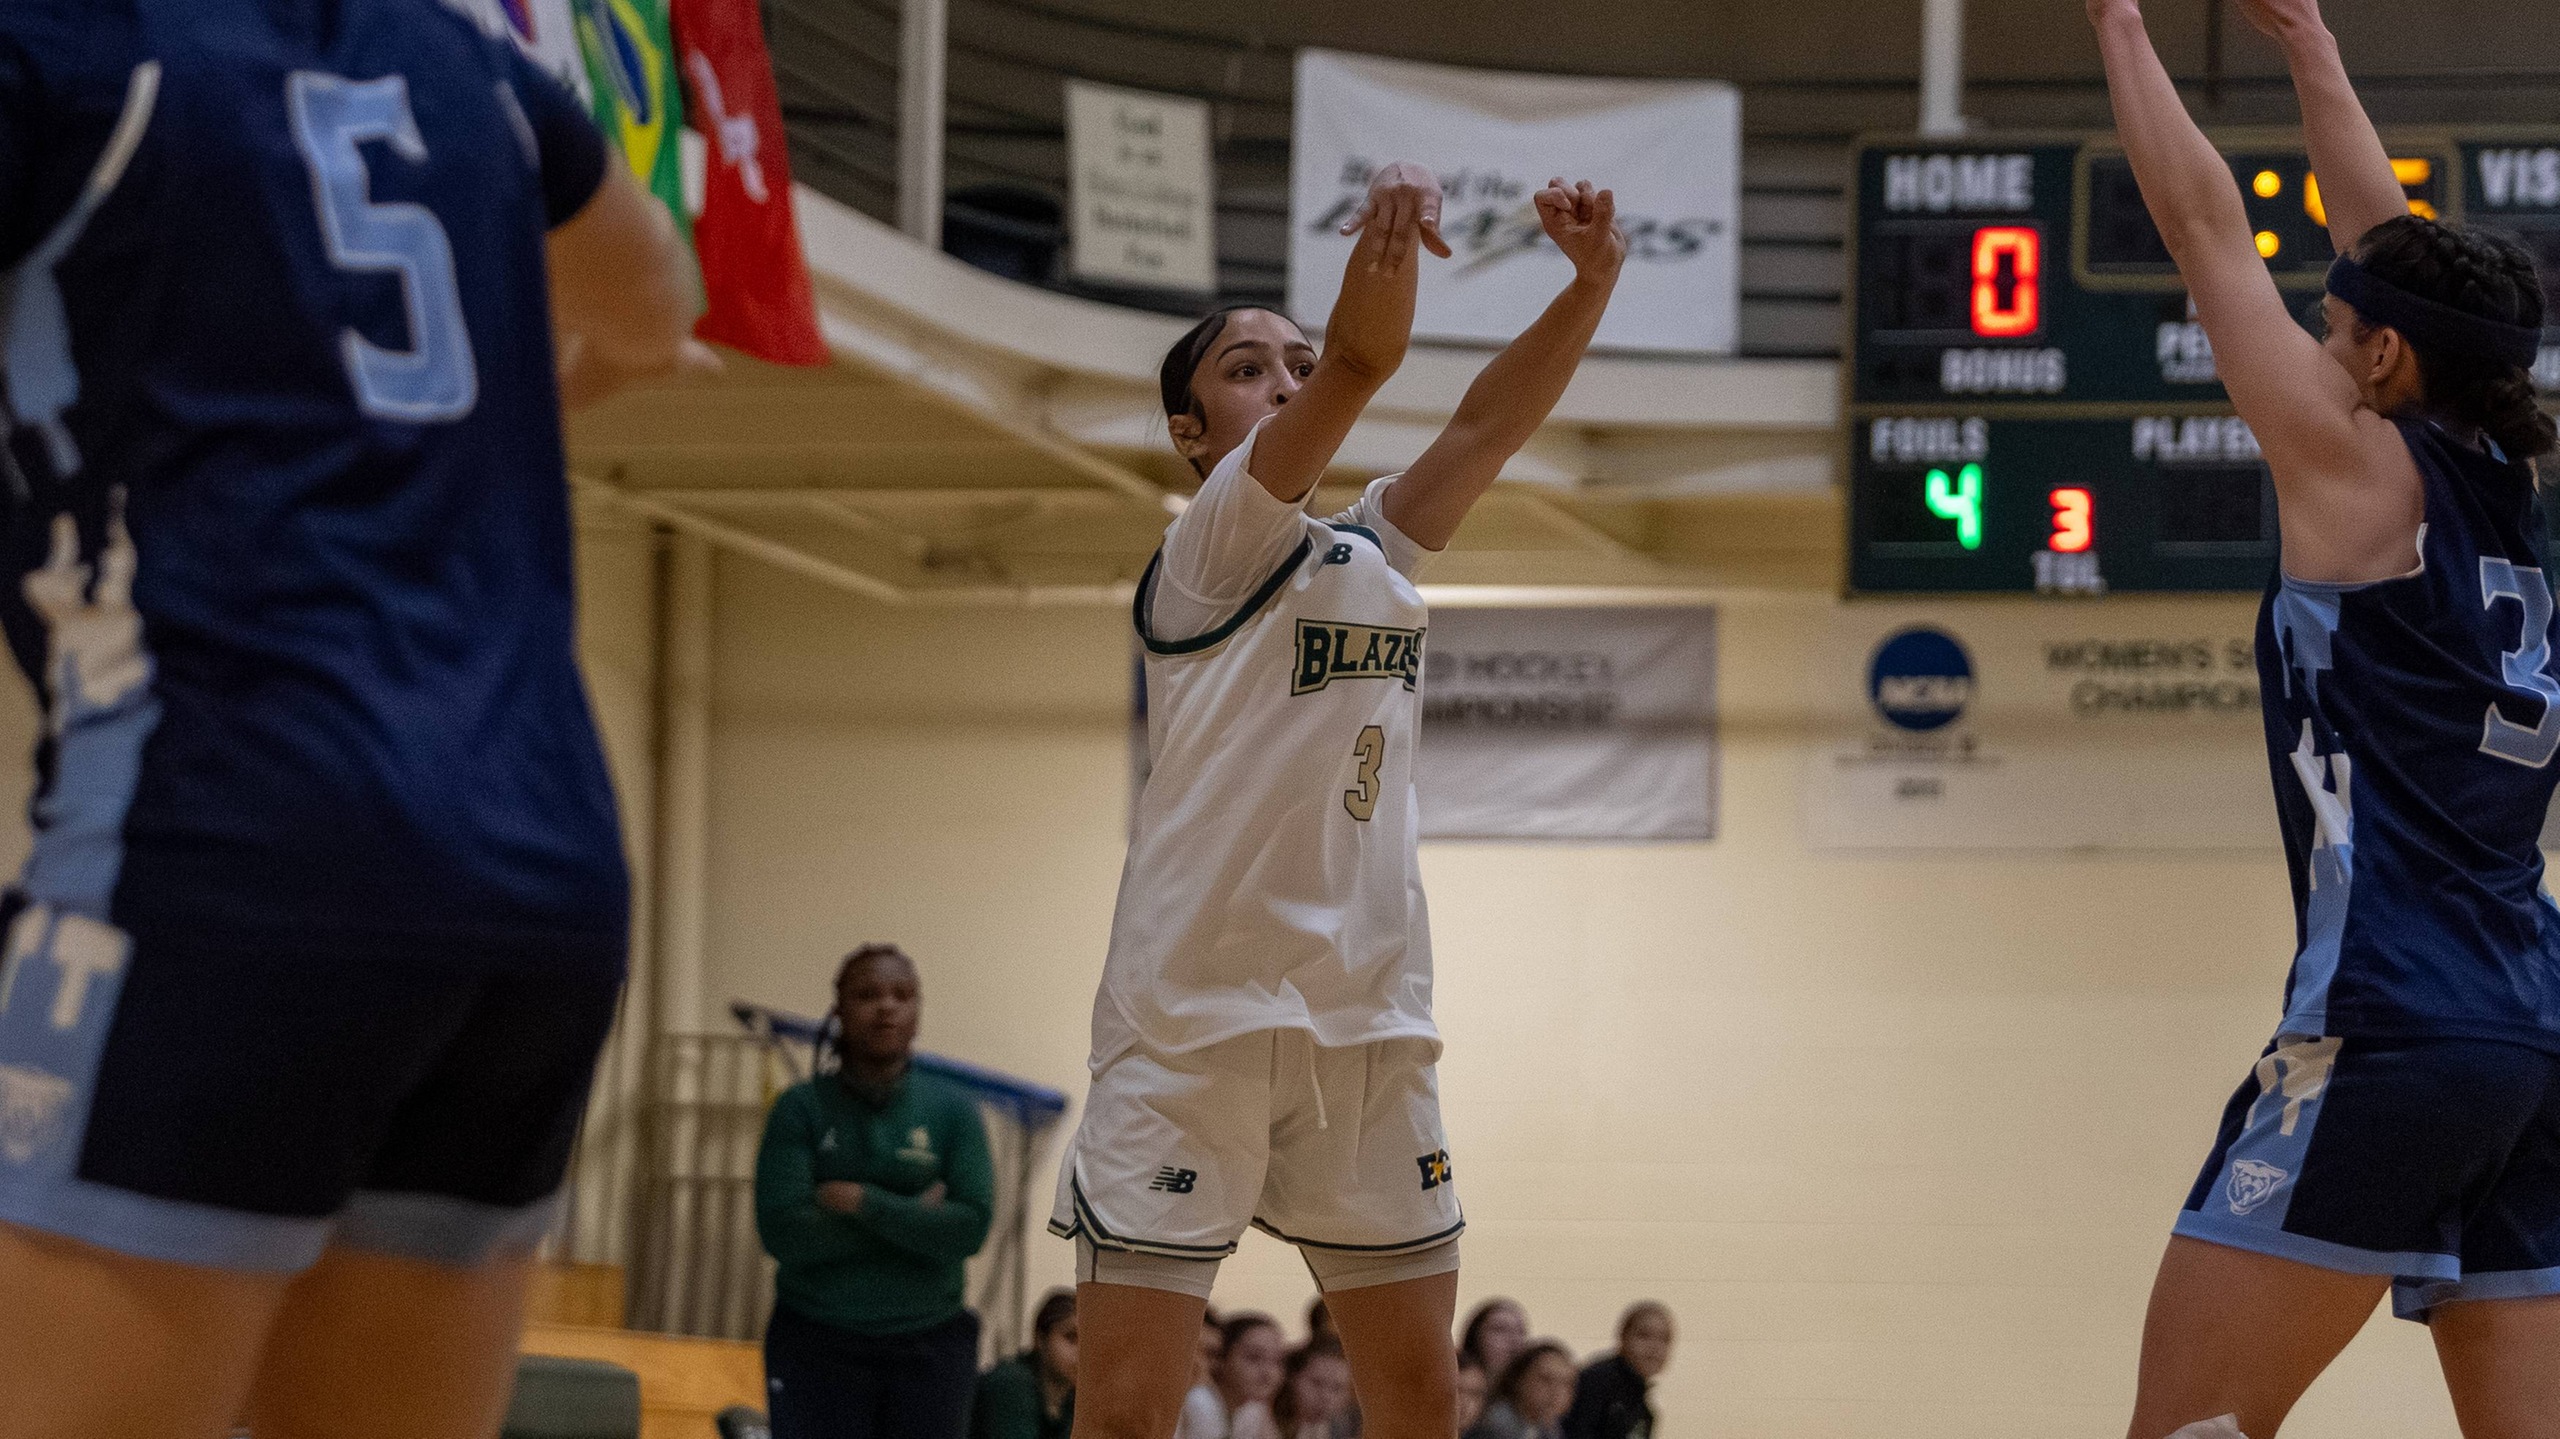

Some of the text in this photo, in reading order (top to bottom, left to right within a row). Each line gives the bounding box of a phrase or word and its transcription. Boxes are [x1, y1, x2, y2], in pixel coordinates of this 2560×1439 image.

[1884, 154, 2035, 211] HOME
[286, 70, 478, 422] 5
[1971, 226, 2040, 338] 0
[1940, 348, 2067, 393] BONUS
[1872, 417, 1988, 463] FOULS
[1925, 463, 1983, 550] 4
[2048, 488, 2094, 552] 3
[2478, 556, 2560, 769] 3
[1344, 726, 1385, 822] 3
